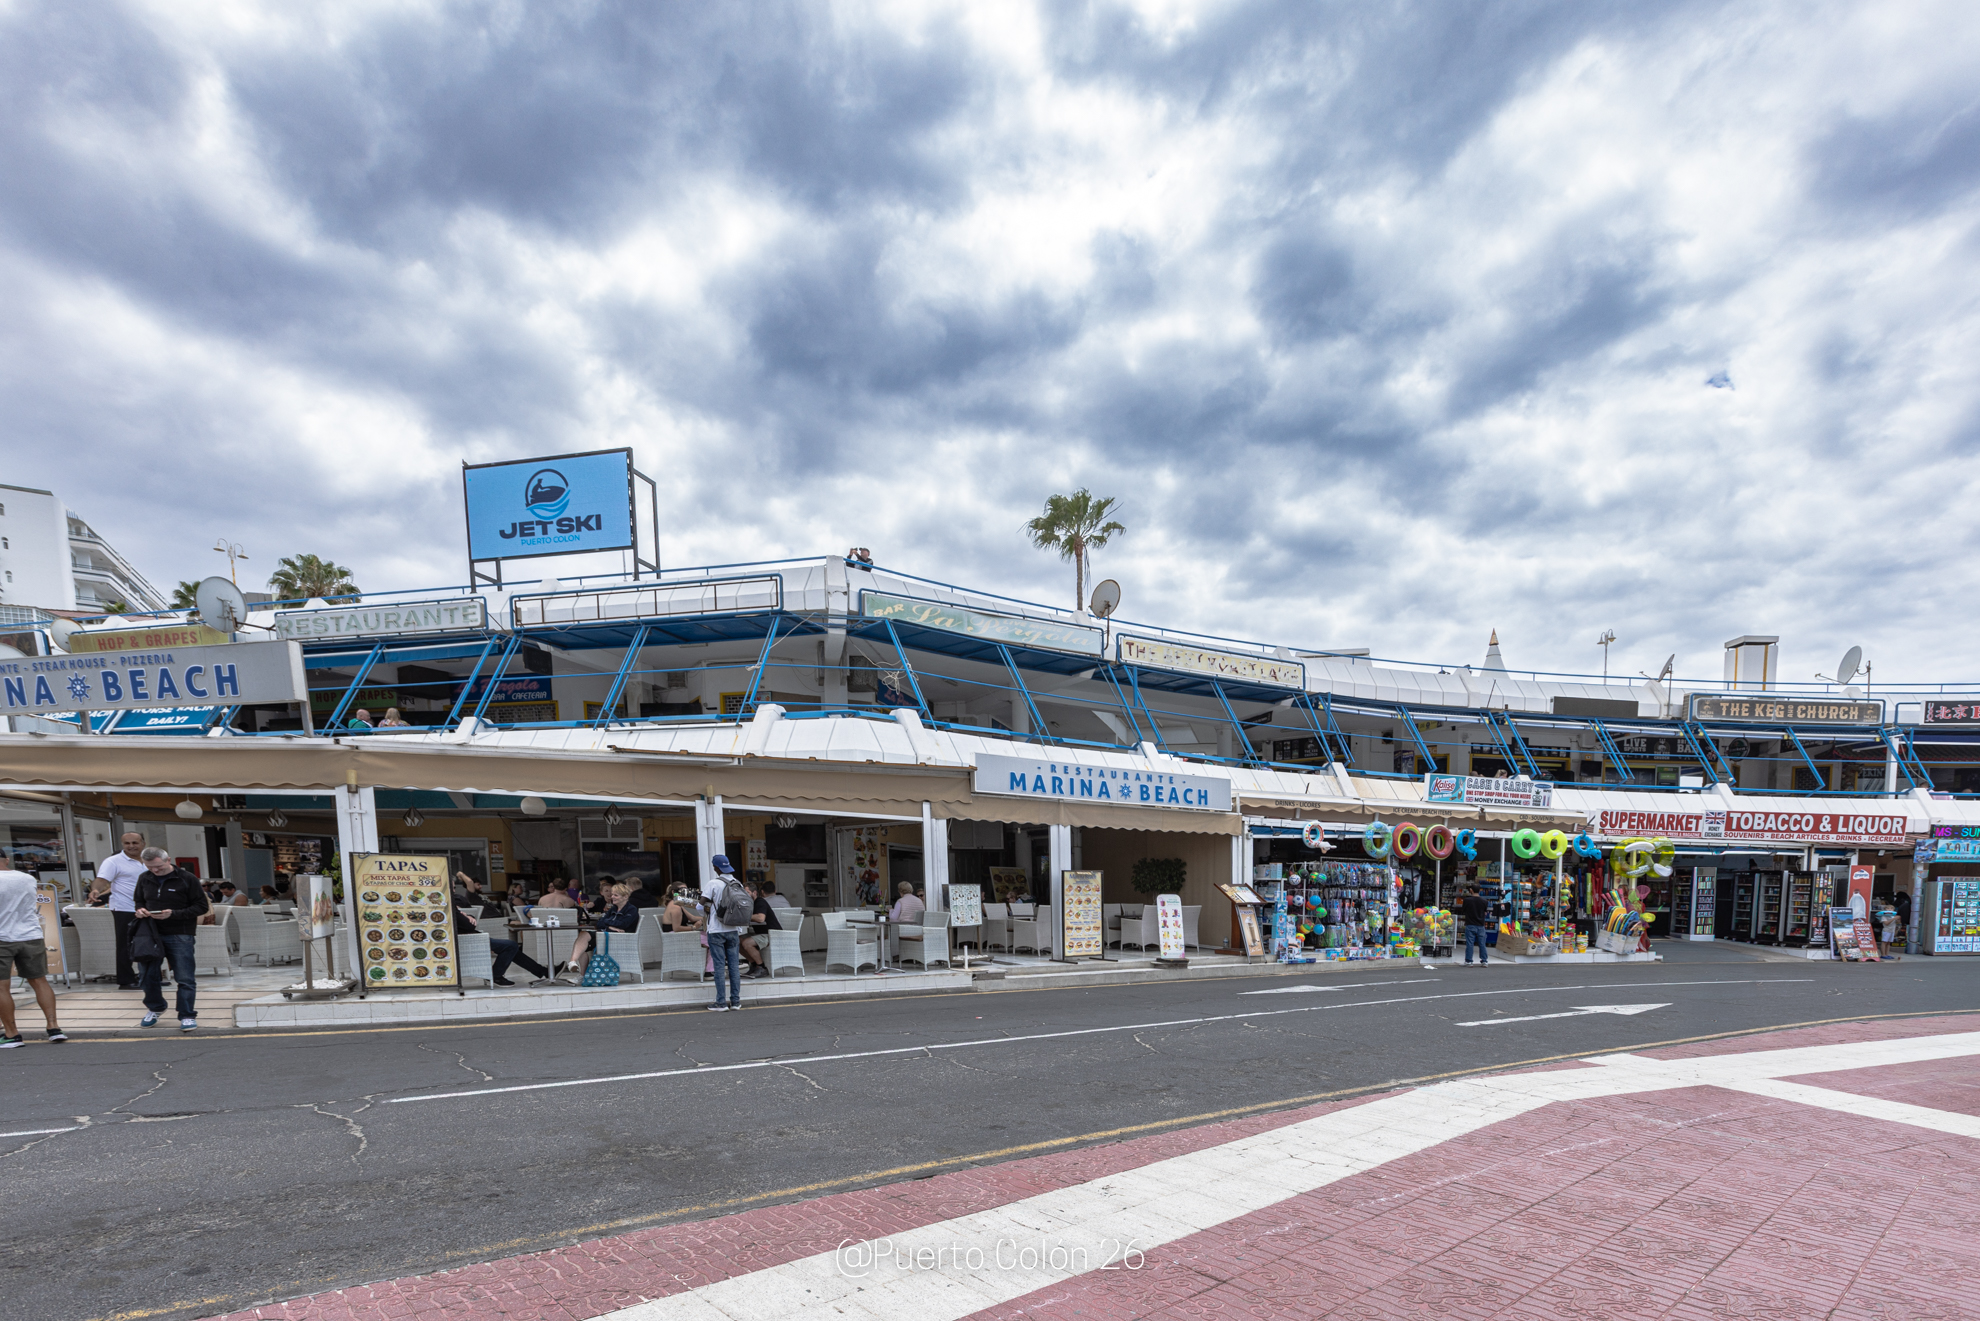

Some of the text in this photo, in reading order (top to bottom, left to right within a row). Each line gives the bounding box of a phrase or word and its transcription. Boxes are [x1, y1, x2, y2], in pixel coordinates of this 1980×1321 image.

[499, 514, 602, 539] JET SKI
[521, 534, 581, 546] PUERTO COLON
[277, 604, 479, 637] RESTAURANTE
[873, 603, 1096, 646] BAR La Pergola
[97, 631, 198, 650] HOP & GRAPES
[1125, 641, 1158, 661] THE
[32, 658, 67, 672] STEAK
[70, 657, 107, 670] HOUSE
[120, 653, 175, 667] PIZZERIA
[100, 662, 241, 702] BEACH
[480, 678, 540, 695] Prgola
[315, 692, 337, 703] HOP
[512, 691, 547, 700] CAFETERIA
[1720, 702, 1750, 717] THE
[1755, 703, 1784, 718] KEG
[1796, 705, 1859, 720] CHURCH
[1934, 704, 1969, 720] 北京
[146, 716, 189, 725] DAILY!
[1623, 738, 1647, 747] LIVE
[1050, 763, 1174, 785] RESTAURANTE
[1009, 771, 1209, 806] MARINA BEACH
[1433, 777, 1456, 793] Kalise
[1466, 777, 1535, 793] CASH & CARRY
[1300, 800, 1321, 808] LICORES
[1494, 798, 1522, 806] EXCHANGE
[1599, 810, 1703, 832] SUPERMARKET
[1729, 812, 1904, 835] TOBACCO & LIQUOR
[1723, 831, 1765, 839] SOUVENIRS
[1796, 833, 1830, 841] ARTICLES
[1868, 835, 1904, 843] ICECREAM
[492, 843, 500, 853] R
[374, 860, 428, 872] TAPAS
